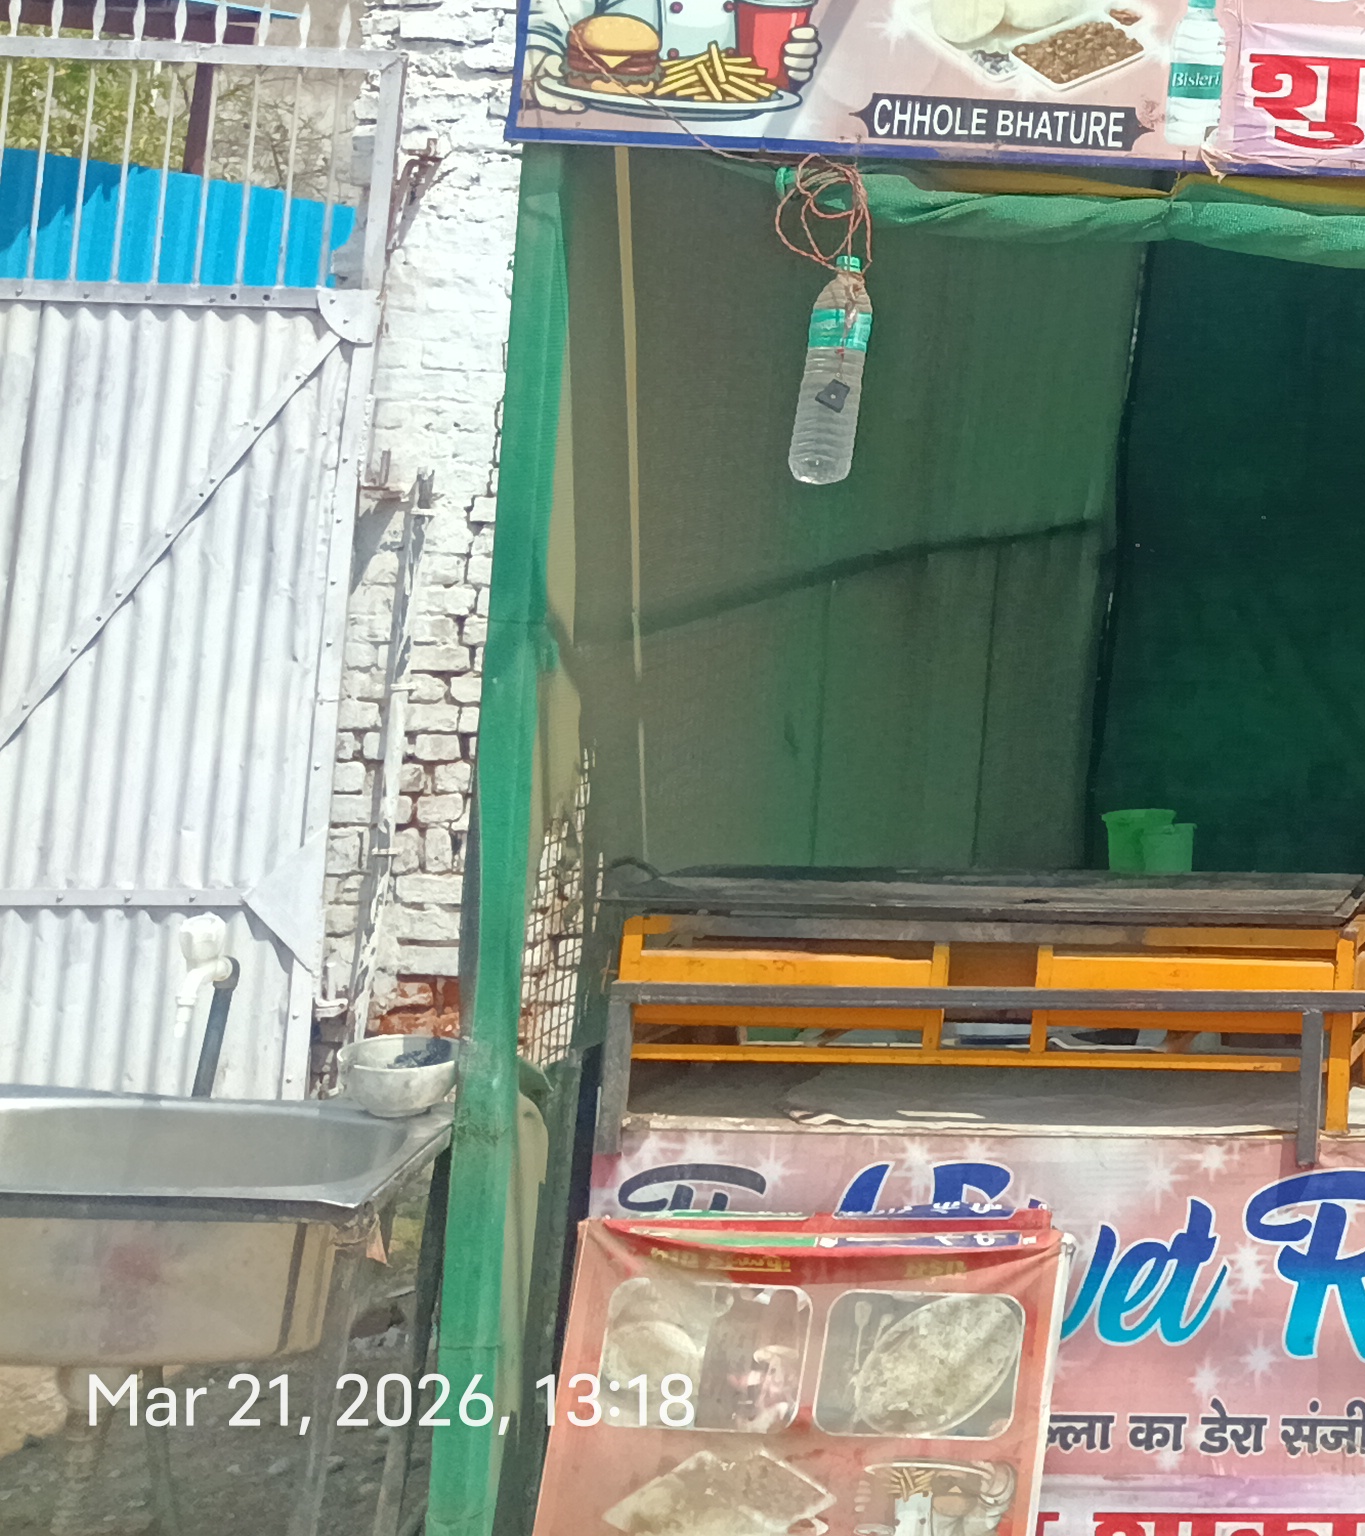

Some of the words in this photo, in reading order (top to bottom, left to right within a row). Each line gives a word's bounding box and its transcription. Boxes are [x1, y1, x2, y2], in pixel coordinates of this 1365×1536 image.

[1172, 71, 1221, 87] Bisleri
[874, 98, 987, 139] CHHOLE
[996, 105, 1125, 148] BHATURE
[1128, 1415, 1187, 1452] का
[1199, 1399, 1268, 1455] डेरा
